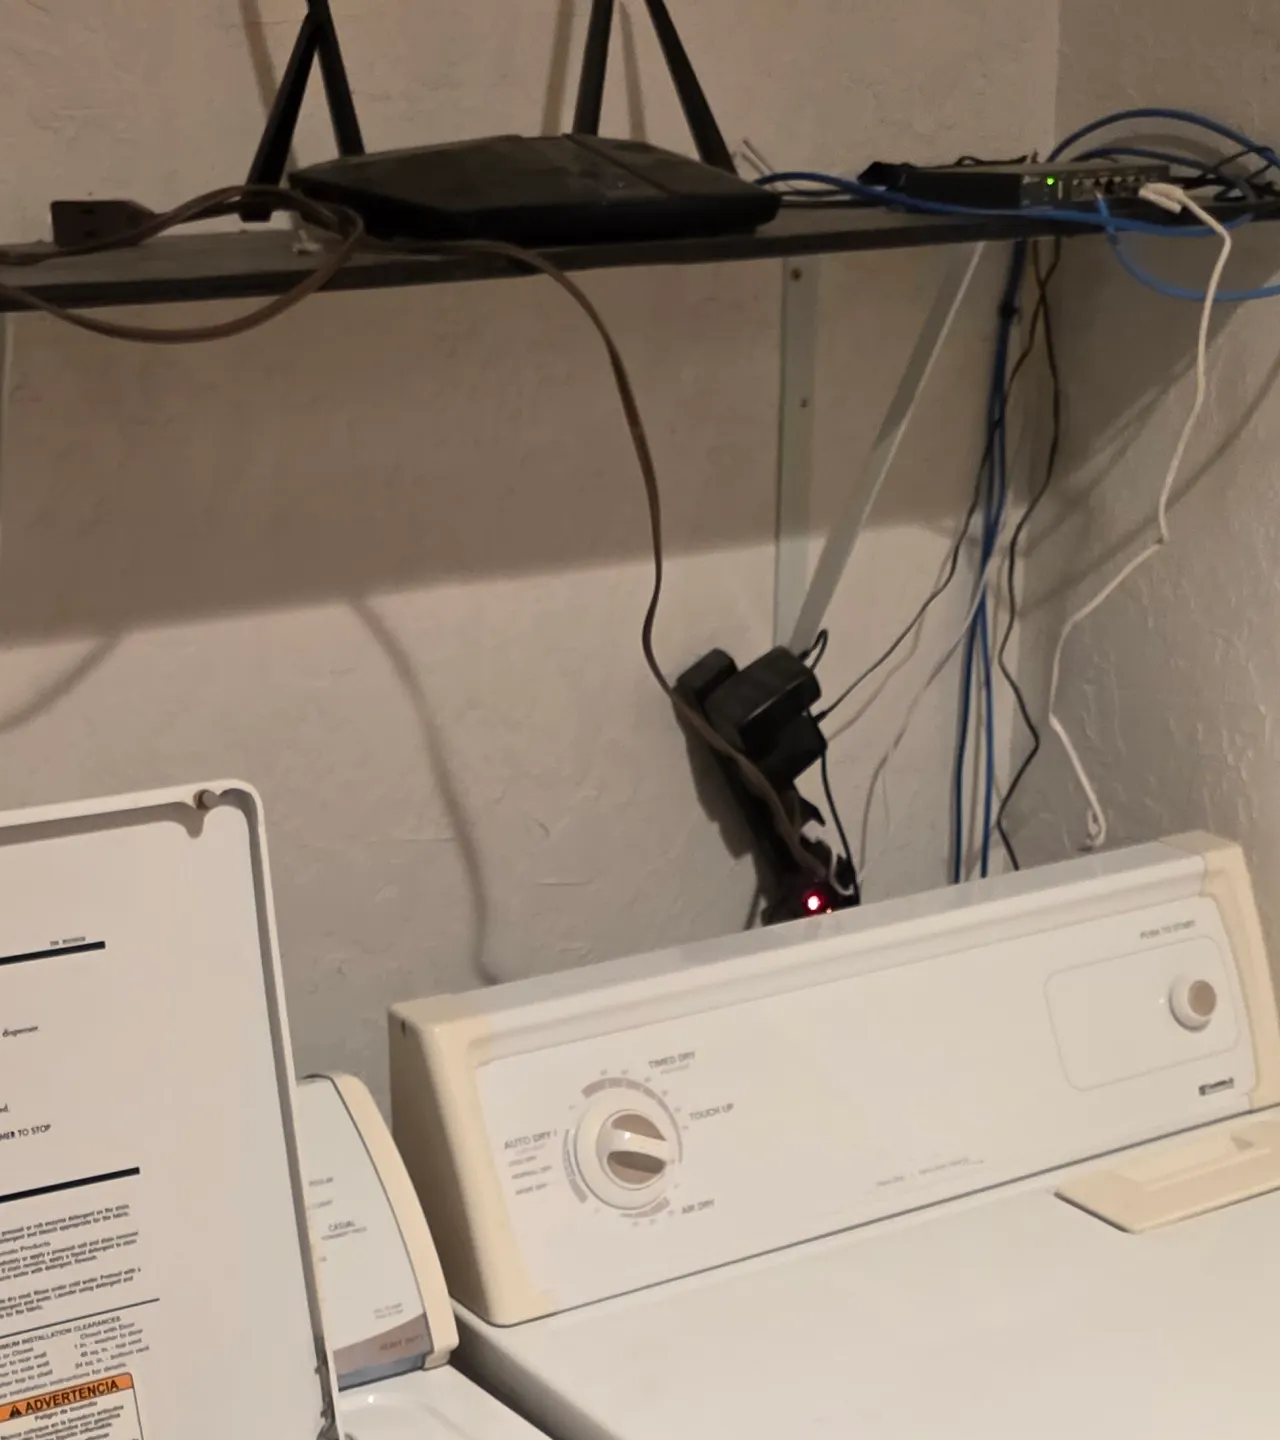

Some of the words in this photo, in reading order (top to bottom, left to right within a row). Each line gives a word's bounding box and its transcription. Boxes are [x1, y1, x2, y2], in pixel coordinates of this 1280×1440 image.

[1, 1025, 39, 1037] dispenser.
[648, 1055, 677, 1069] TIMED
[677, 1050, 696, 1063] DRY
[688, 1106, 720, 1121] TOUCH
[721, 1102, 735, 1114] UP
[30, 1123, 52, 1135] STOP
[504, 1135, 531, 1150] AUTO
[532, 1130, 552, 1143] DRY
[328, 1219, 356, 1233] CASUAL
[24, 1379, 120, 1414] ADVERTENCIA
